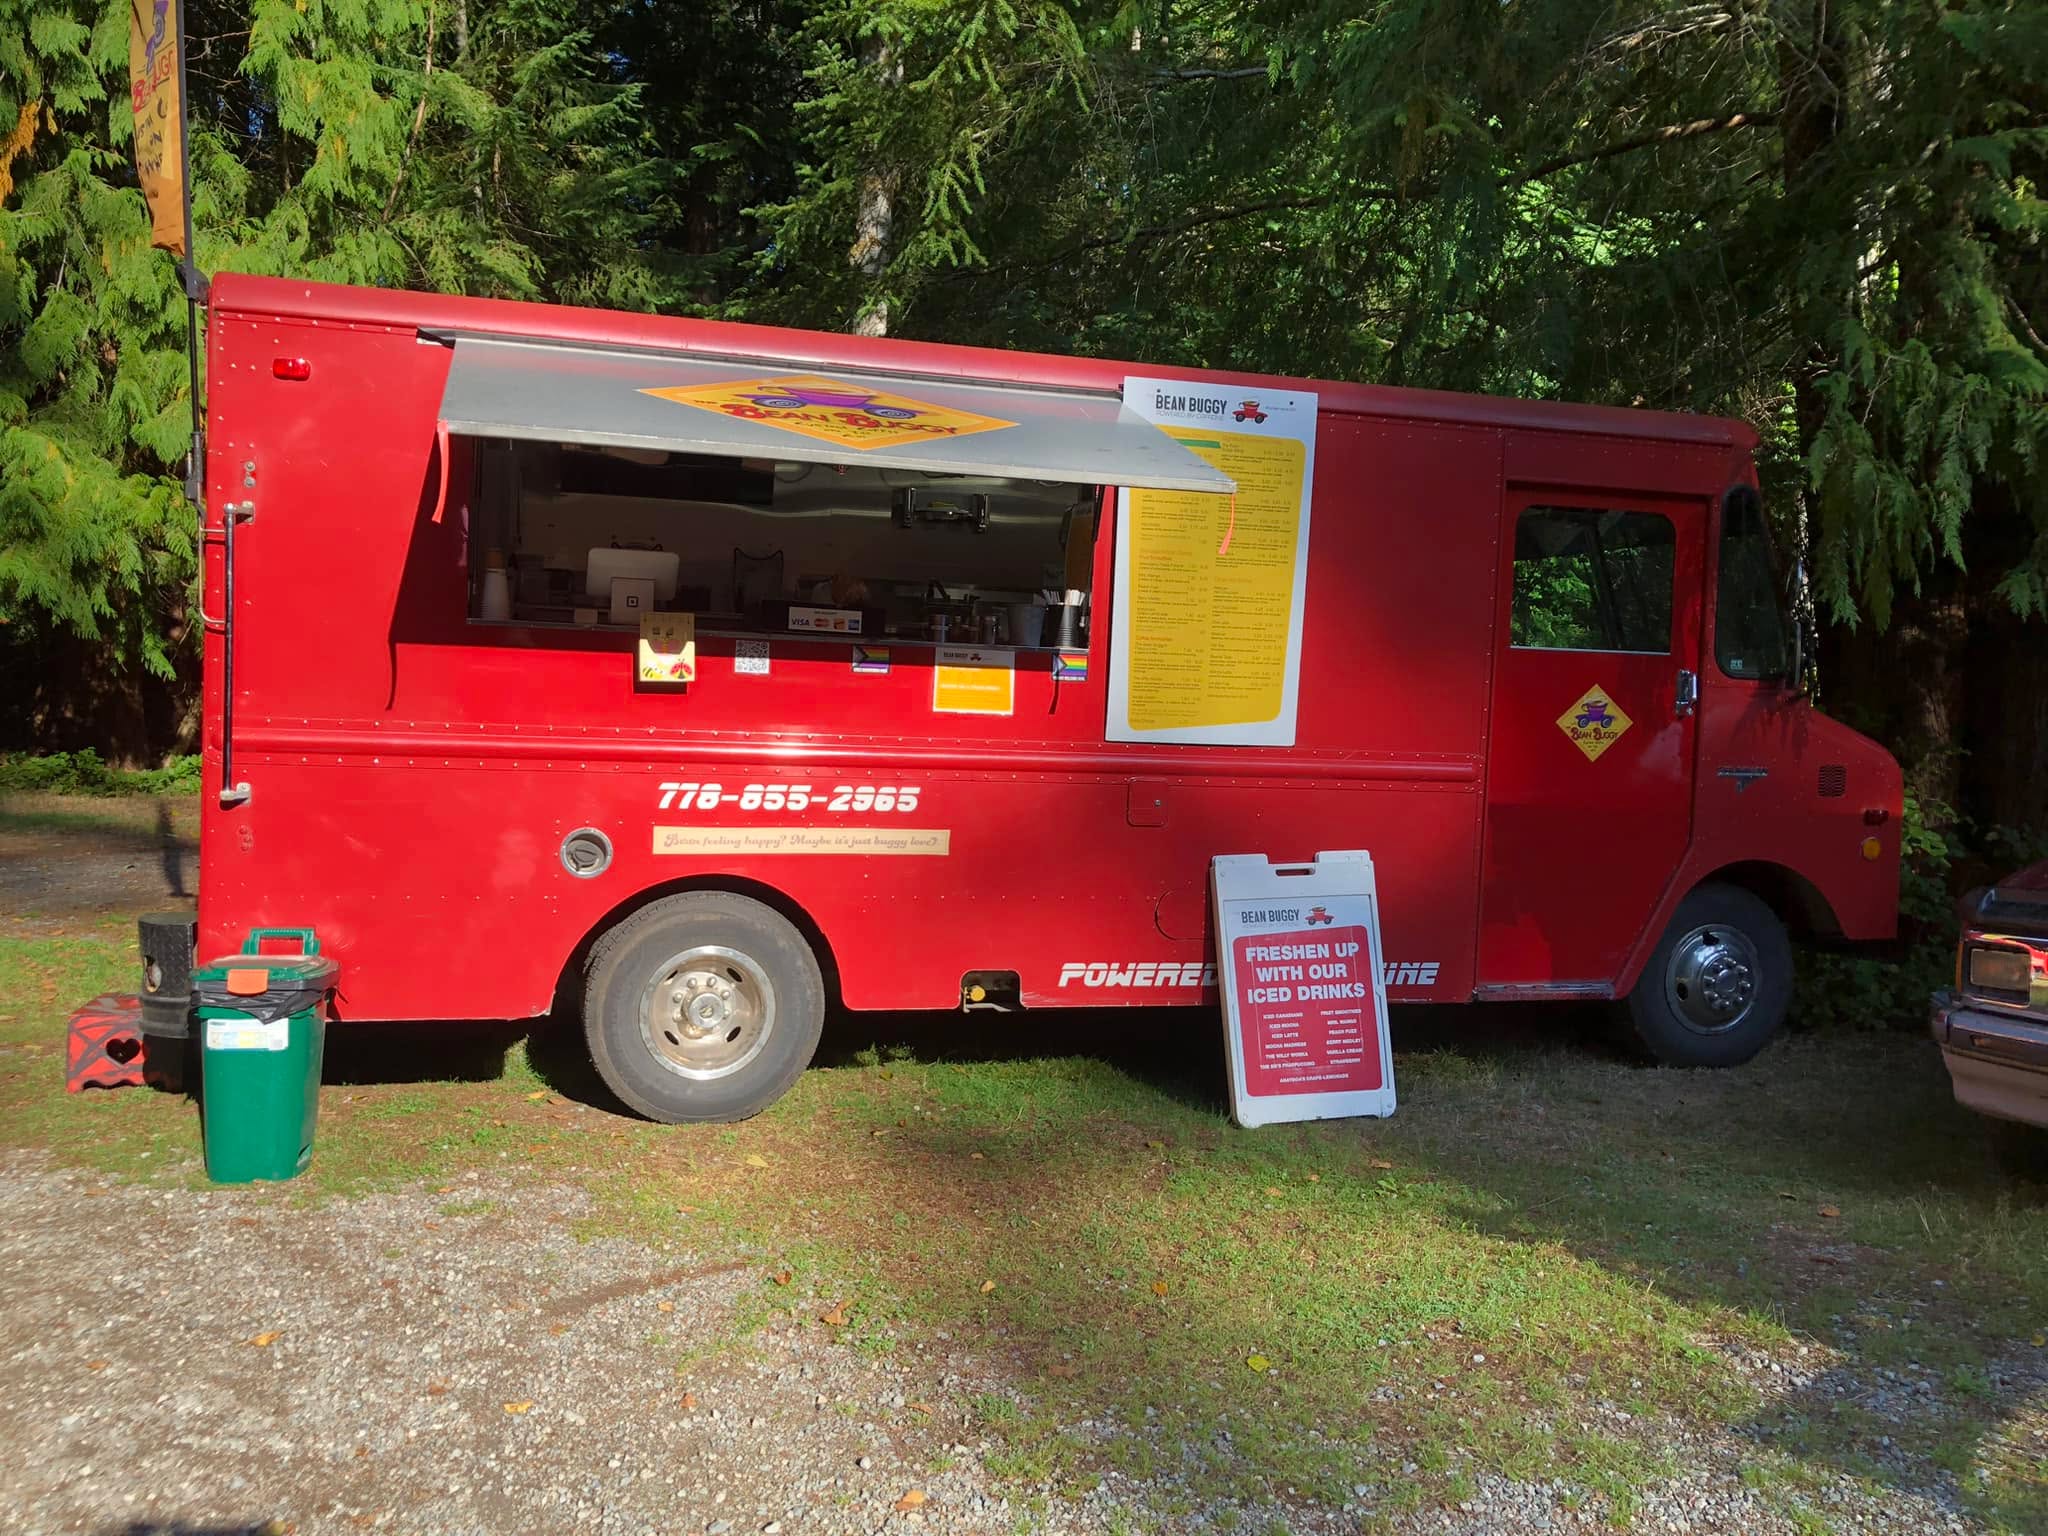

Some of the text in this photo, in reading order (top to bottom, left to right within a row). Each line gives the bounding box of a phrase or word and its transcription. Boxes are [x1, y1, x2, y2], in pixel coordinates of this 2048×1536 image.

[1155, 394, 1227, 415] BEAN BUGGY
[719, 403, 829, 422] BEAN
[832, 412, 958, 434] BUGGY
[791, 617, 809, 626] VISA
[658, 782, 921, 812] 778-855-2965
[702, 836, 741, 848] feeling
[744, 834, 787, 848] happy?
[790, 833, 831, 848] Maybe
[848, 836, 872, 848] just
[874, 835, 907, 849] buggy
[1241, 909, 1299, 923] BEAN BUGGY
[1245, 942, 1359, 962] FRESHEN UP
[1256, 963, 1347, 982] WITH OUR
[1247, 982, 1366, 1004] ICED DRINKS
